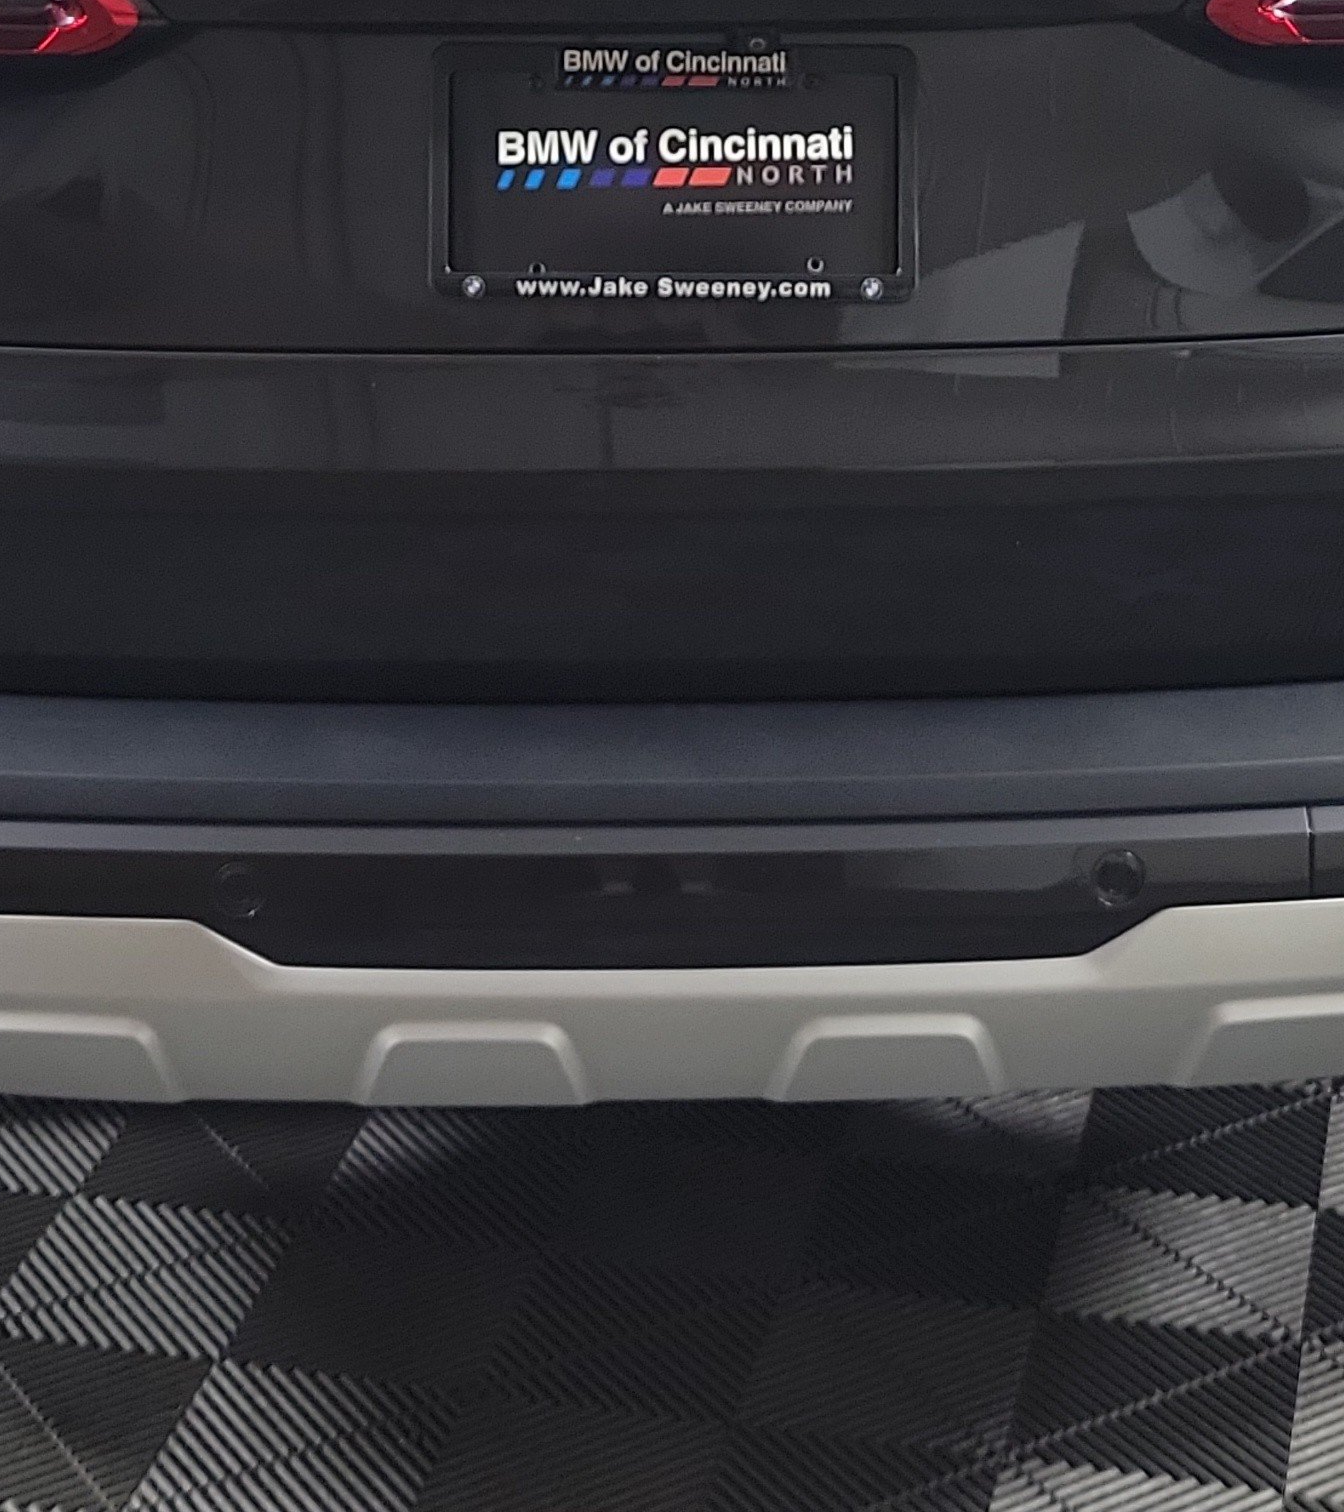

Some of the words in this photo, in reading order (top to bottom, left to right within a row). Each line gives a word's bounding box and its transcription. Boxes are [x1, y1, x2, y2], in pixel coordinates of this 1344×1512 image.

[563, 49, 629, 72] BMW
[634, 49, 661, 72] of
[666, 49, 787, 74] Cincinnati
[727, 76, 787, 87] NORTH
[497, 129, 598, 166] BMW
[609, 128, 650, 165] of
[658, 124, 854, 164] Cincinnati
[736, 163, 853, 186] NORTH
[662, 201, 674, 215] A
[675, 201, 713, 215] JAKE
[714, 200, 782, 214] SWEENEY
[784, 198, 853, 214] COMPANY
